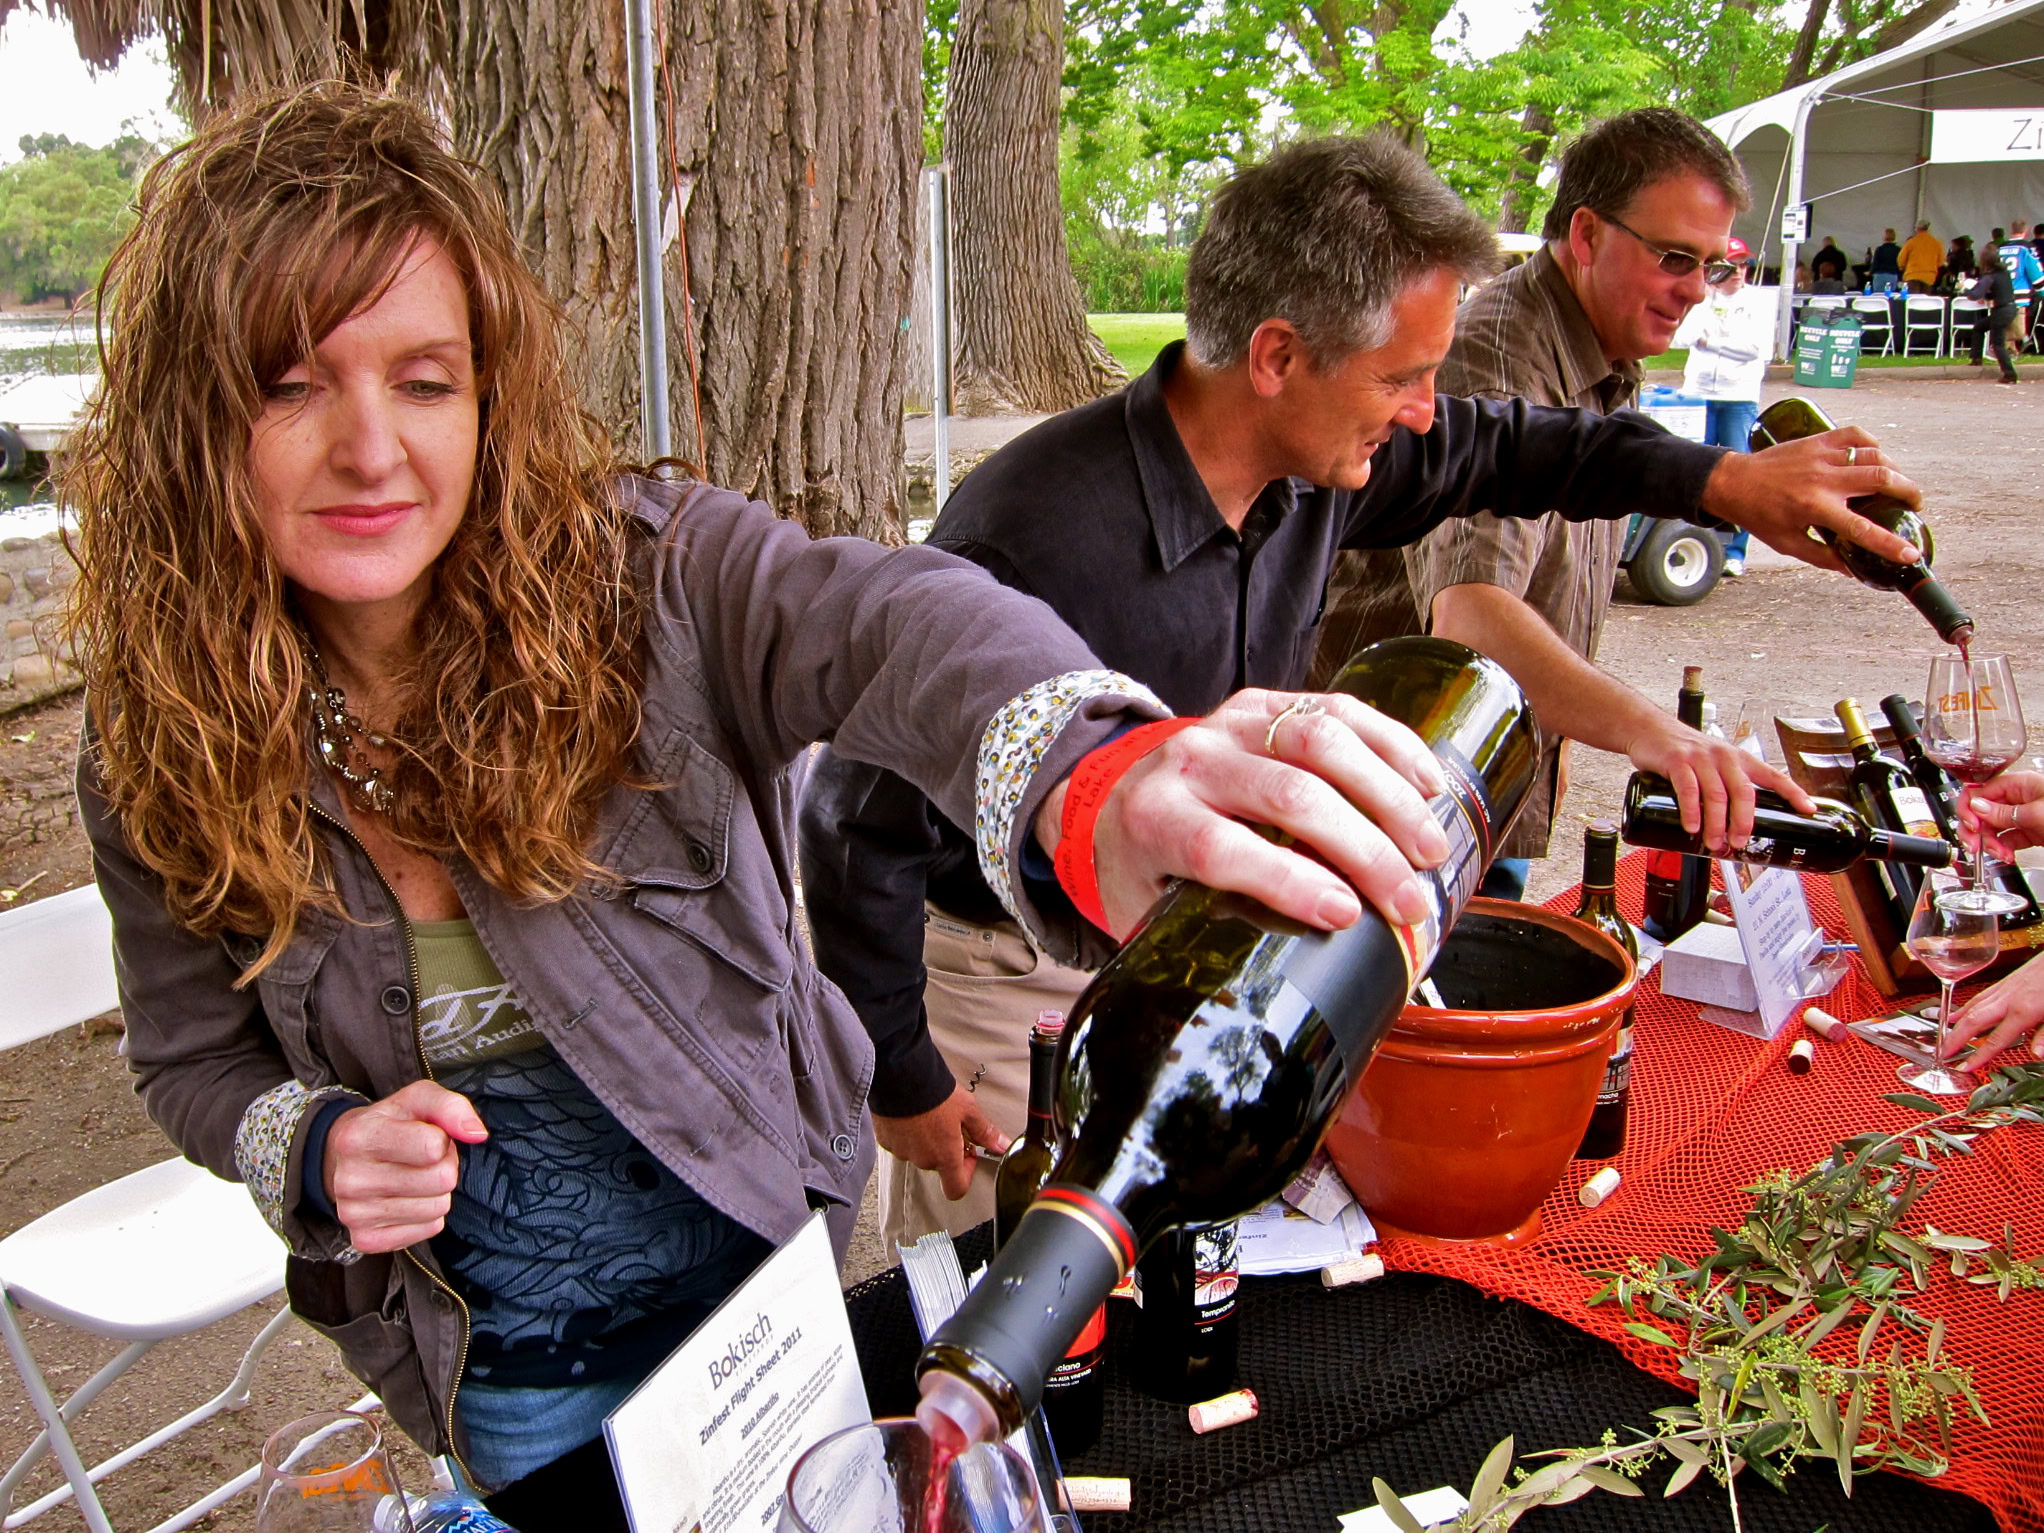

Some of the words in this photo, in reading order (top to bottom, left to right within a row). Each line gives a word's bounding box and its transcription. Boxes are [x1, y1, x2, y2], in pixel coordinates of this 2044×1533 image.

[1829, 329, 1861, 337] RECYCLE
[1064, 795, 1081, 841] Food
[1079, 777, 1090, 789] &
[1084, 768, 1114, 809] Lake
[708, 1312, 773, 1390] Bokisch
[699, 1404, 731, 1446] Zinfest
[730, 1376, 756, 1411] Flight
[755, 1349, 781, 1383] Sheet
[781, 1326, 803, 1355] 2011
[740, 1417, 756, 1441] 2010
